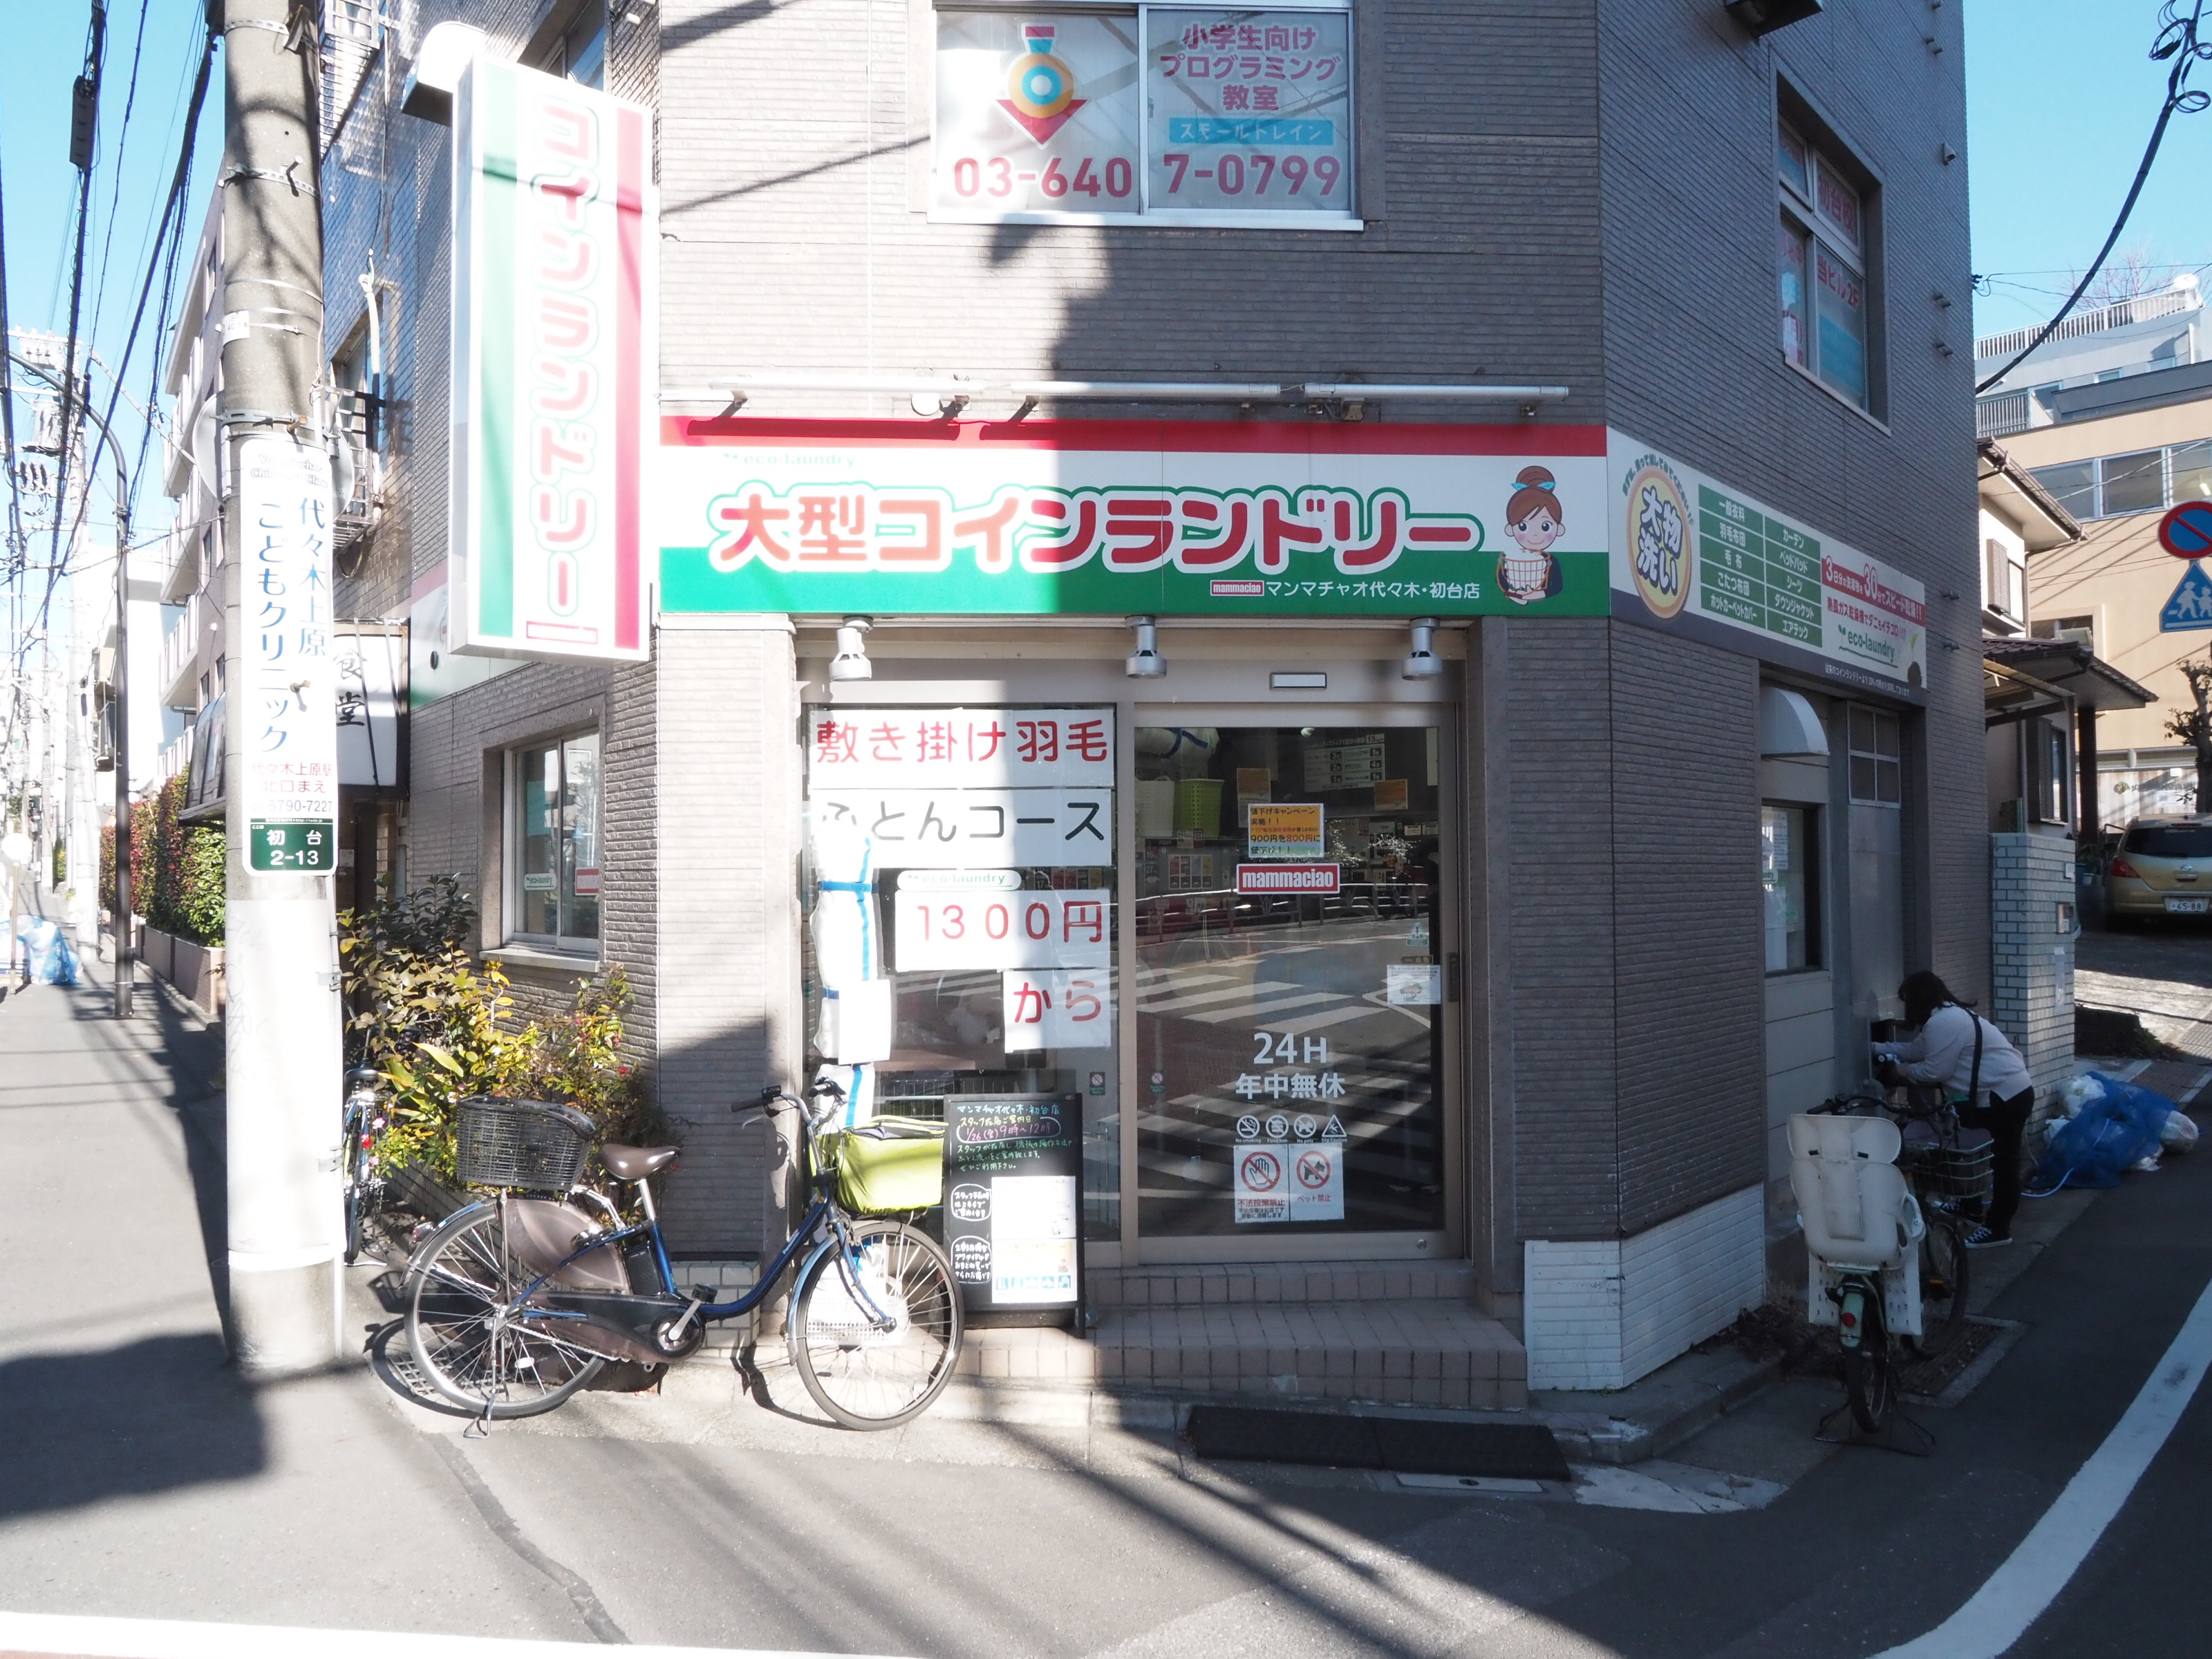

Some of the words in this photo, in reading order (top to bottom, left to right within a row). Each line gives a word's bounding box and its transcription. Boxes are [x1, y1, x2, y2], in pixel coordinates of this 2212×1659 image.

[1182, 25, 1316, 52] 小学生向け
[1160, 53, 1340, 81] プログラミング
[1223, 85, 1279, 111] 教室
[1181, 123, 1322, 141] スモールトレイン
[536, 99, 595, 612] コインランドリー
[744, 451, 856, 470] eco-laundry
[716, 489, 1475, 570] 大型コインランドリー
[1720, 522, 1746, 547] 羽毛布団
[297, 497, 326, 657] 代々木上原
[1212, 582, 1262, 595] mammaciao
[1266, 580, 1481, 600] マンマチャオ代々木・初台店
[256, 502, 288, 752] こどもクリニック
[1848, 631, 1895, 663] eco-laundry
[817, 720, 1107, 763] 敷き掛け羽毛
[263, 780, 326, 793] 北口まえ
[822, 800, 1105, 843] ふとんコース
[1250, 834, 1320, 843] 900円を800円に
[270, 850, 319, 865] 2-13
[922, 873, 1006, 886] eco-laundry
[1242, 869, 1333, 888] mammaciao
[1013, 980, 1102, 1024] から
[1235, 1073, 1347, 1100] 年中無休
[1297, 1194, 1331, 1203] ペット禁止
